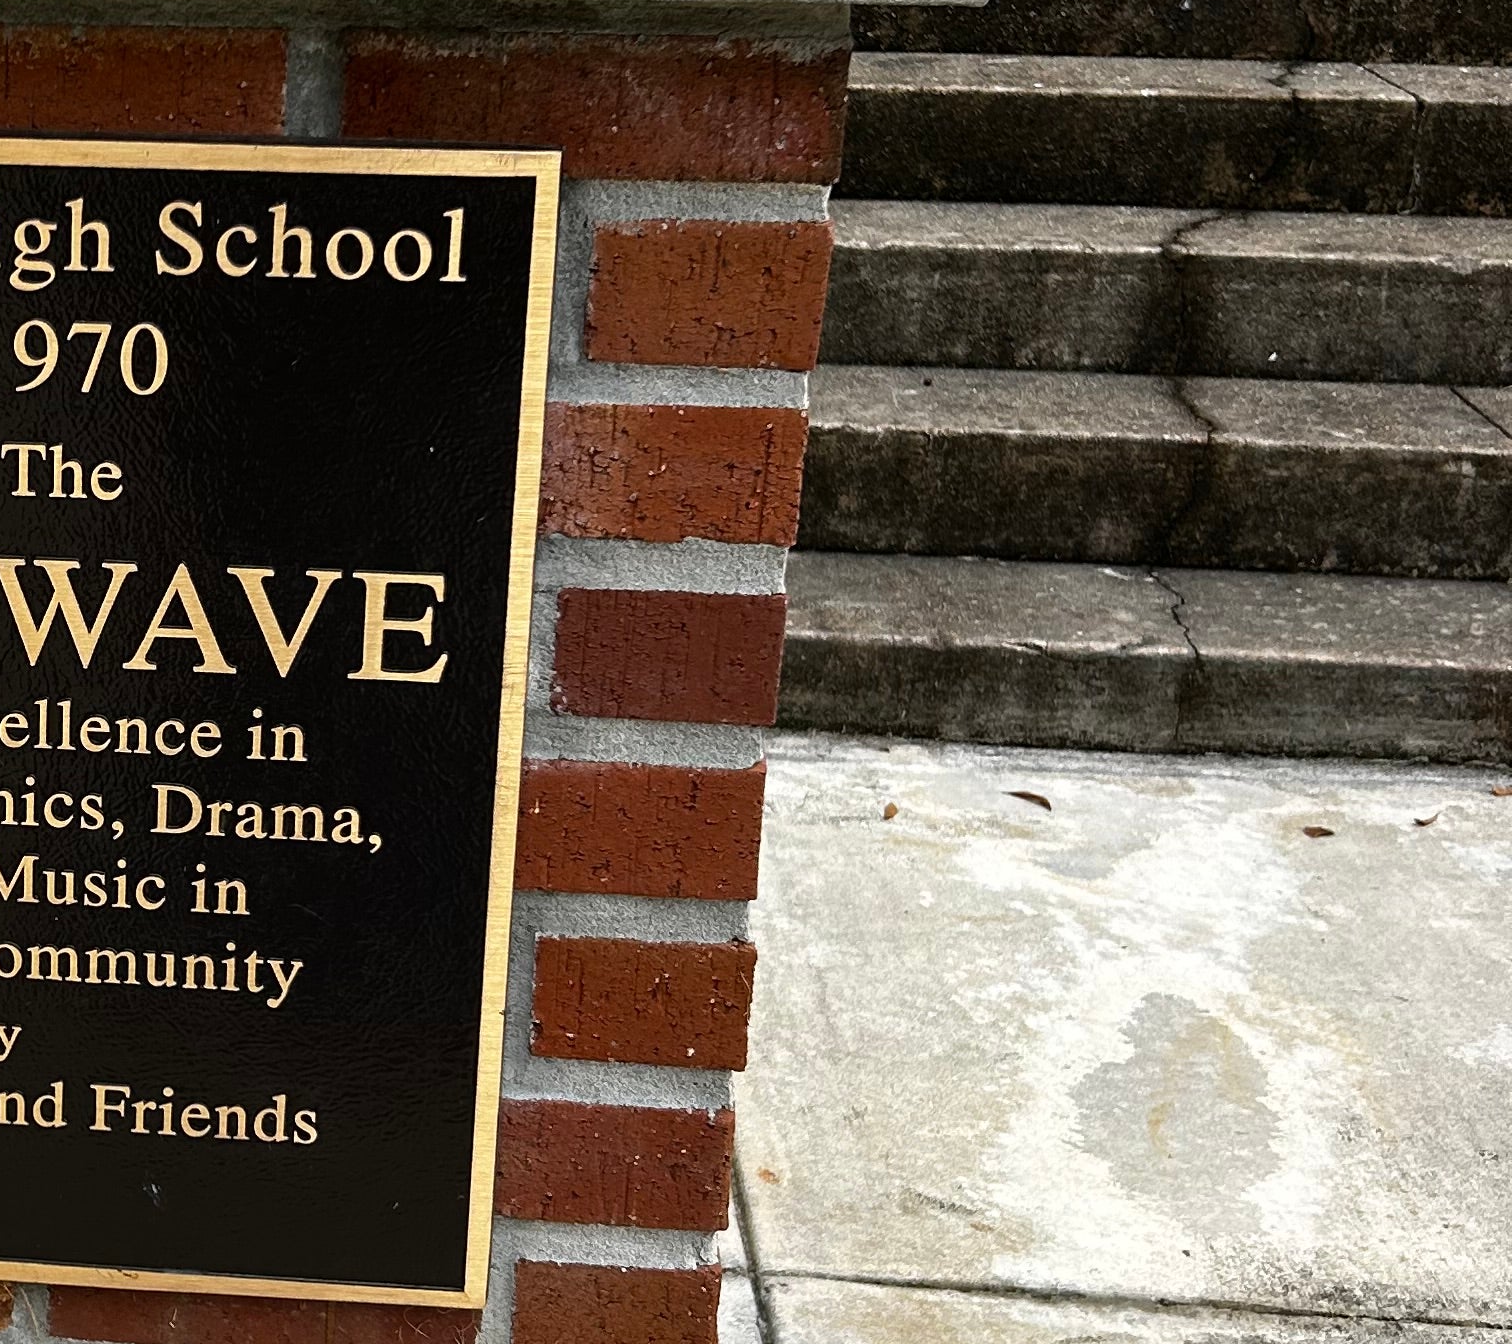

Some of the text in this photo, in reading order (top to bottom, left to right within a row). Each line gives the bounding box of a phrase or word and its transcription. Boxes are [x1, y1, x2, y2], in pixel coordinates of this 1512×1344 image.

[156, 201, 466, 282] School
[1, 443, 123, 500] The
[246, 708, 307, 761] in
[150, 785, 381, 853] Drama,
[191, 864, 250, 915] in
[89, 1084, 317, 1144] Friends
